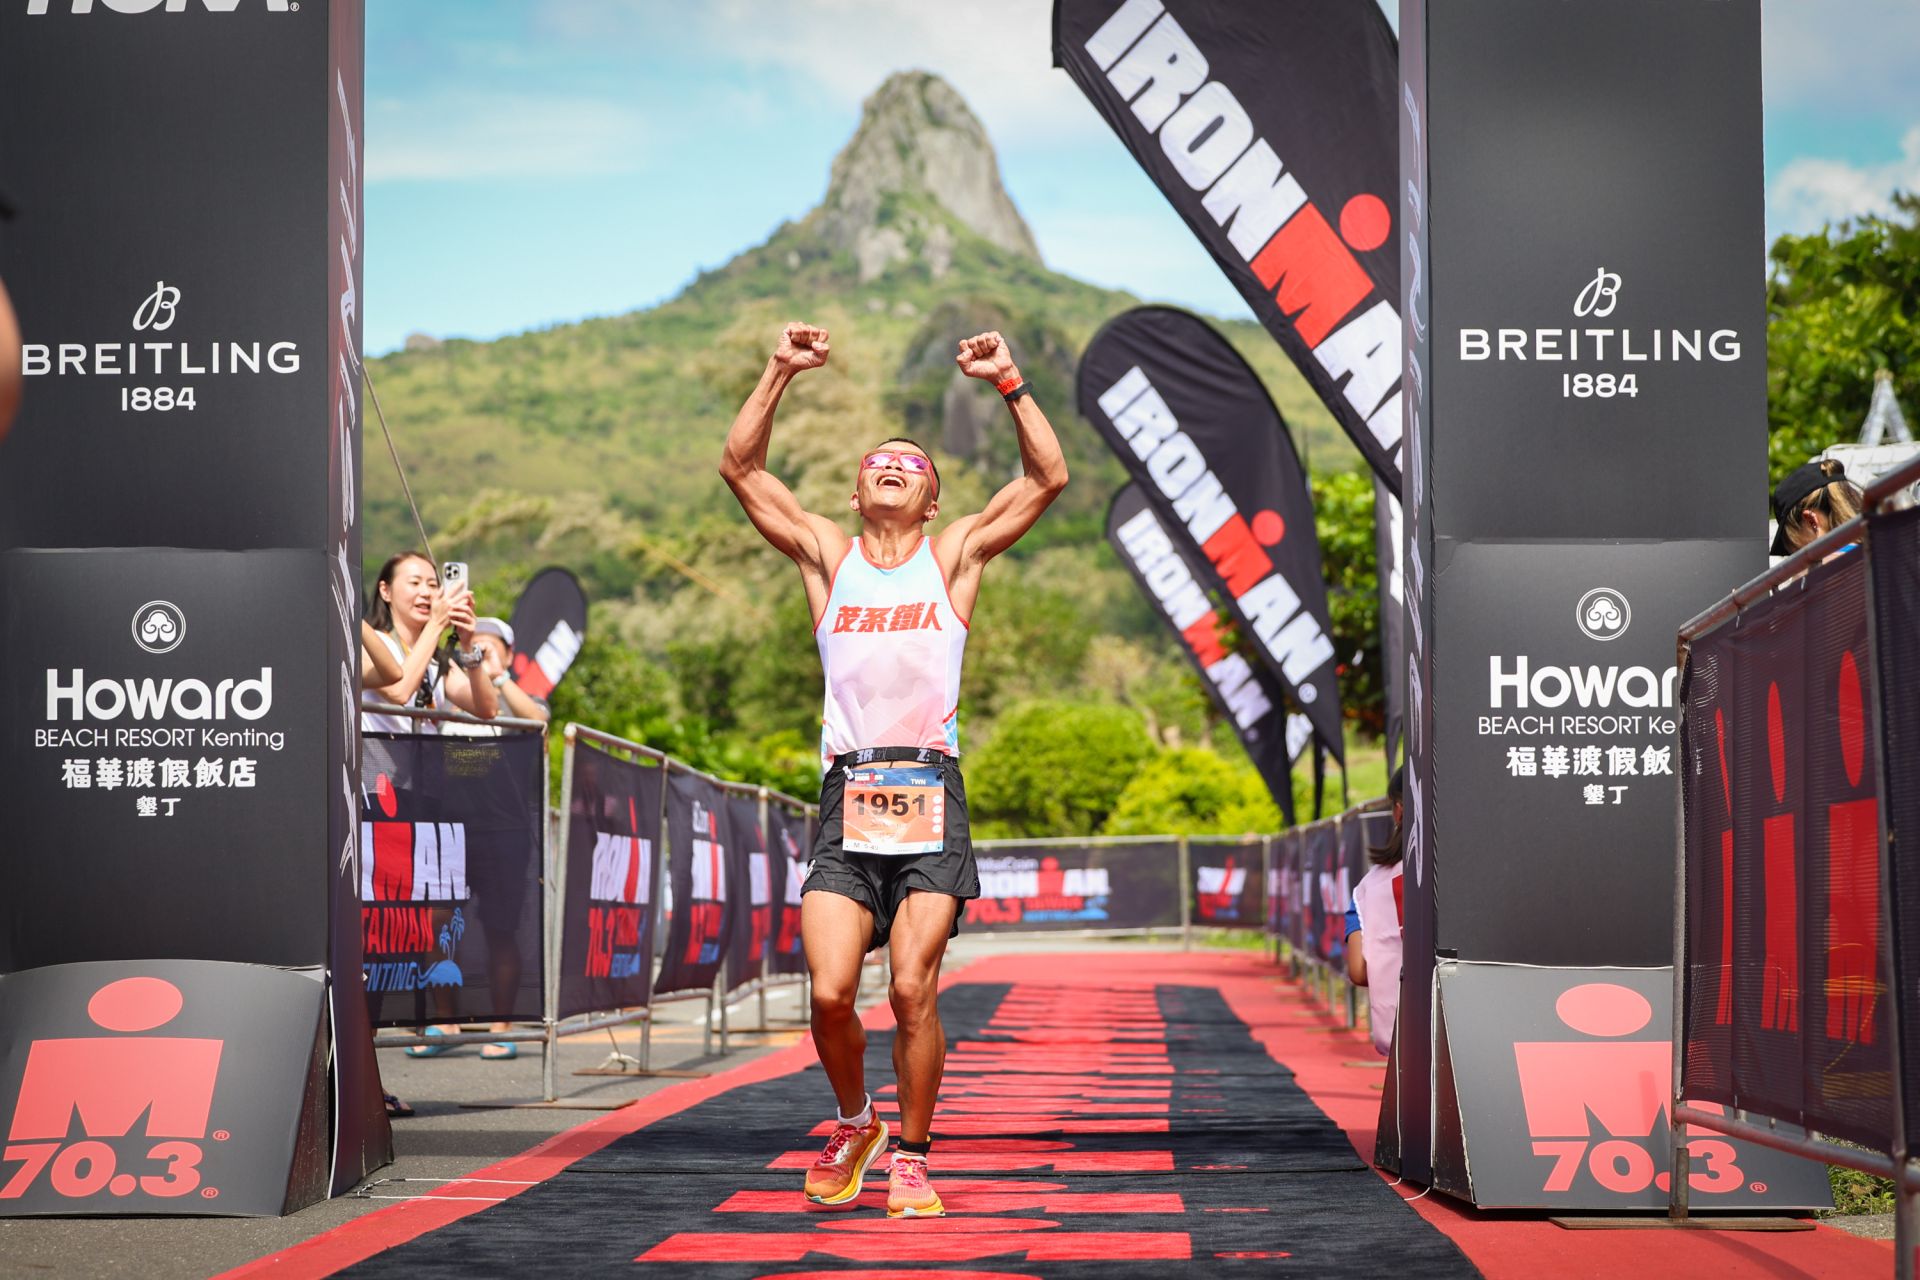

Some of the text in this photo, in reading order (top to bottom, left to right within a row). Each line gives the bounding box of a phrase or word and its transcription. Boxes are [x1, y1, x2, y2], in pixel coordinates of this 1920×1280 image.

[1084, 0, 1402, 475] IRONMA
[22, 341, 301, 376] BREITLING
[1458, 328, 1742, 362] BREITLING
[121, 387, 197, 411] 1884
[1562, 373, 1639, 398] 1884
[1097, 365, 1335, 686] IRONMAN
[46, 667, 272, 720] Howard
[1489, 655, 1677, 708] Howar
[35, 729, 285, 751] BEACH RESORT Kenting
[1478, 716, 1554, 735] BEACH
[1561, 716, 1642, 735] RESORT
[61, 757, 258, 790] 福華渡假飯店
[1506, 745, 1673, 778] 福華渡假飯
[136, 796, 182, 817] 墾丁
[852, 793, 926, 816] 1951
[1583, 783, 1628, 805] 墾丁
[0, 1141, 203, 1198] 70.3
[1531, 1139, 1744, 1193] 70.3
